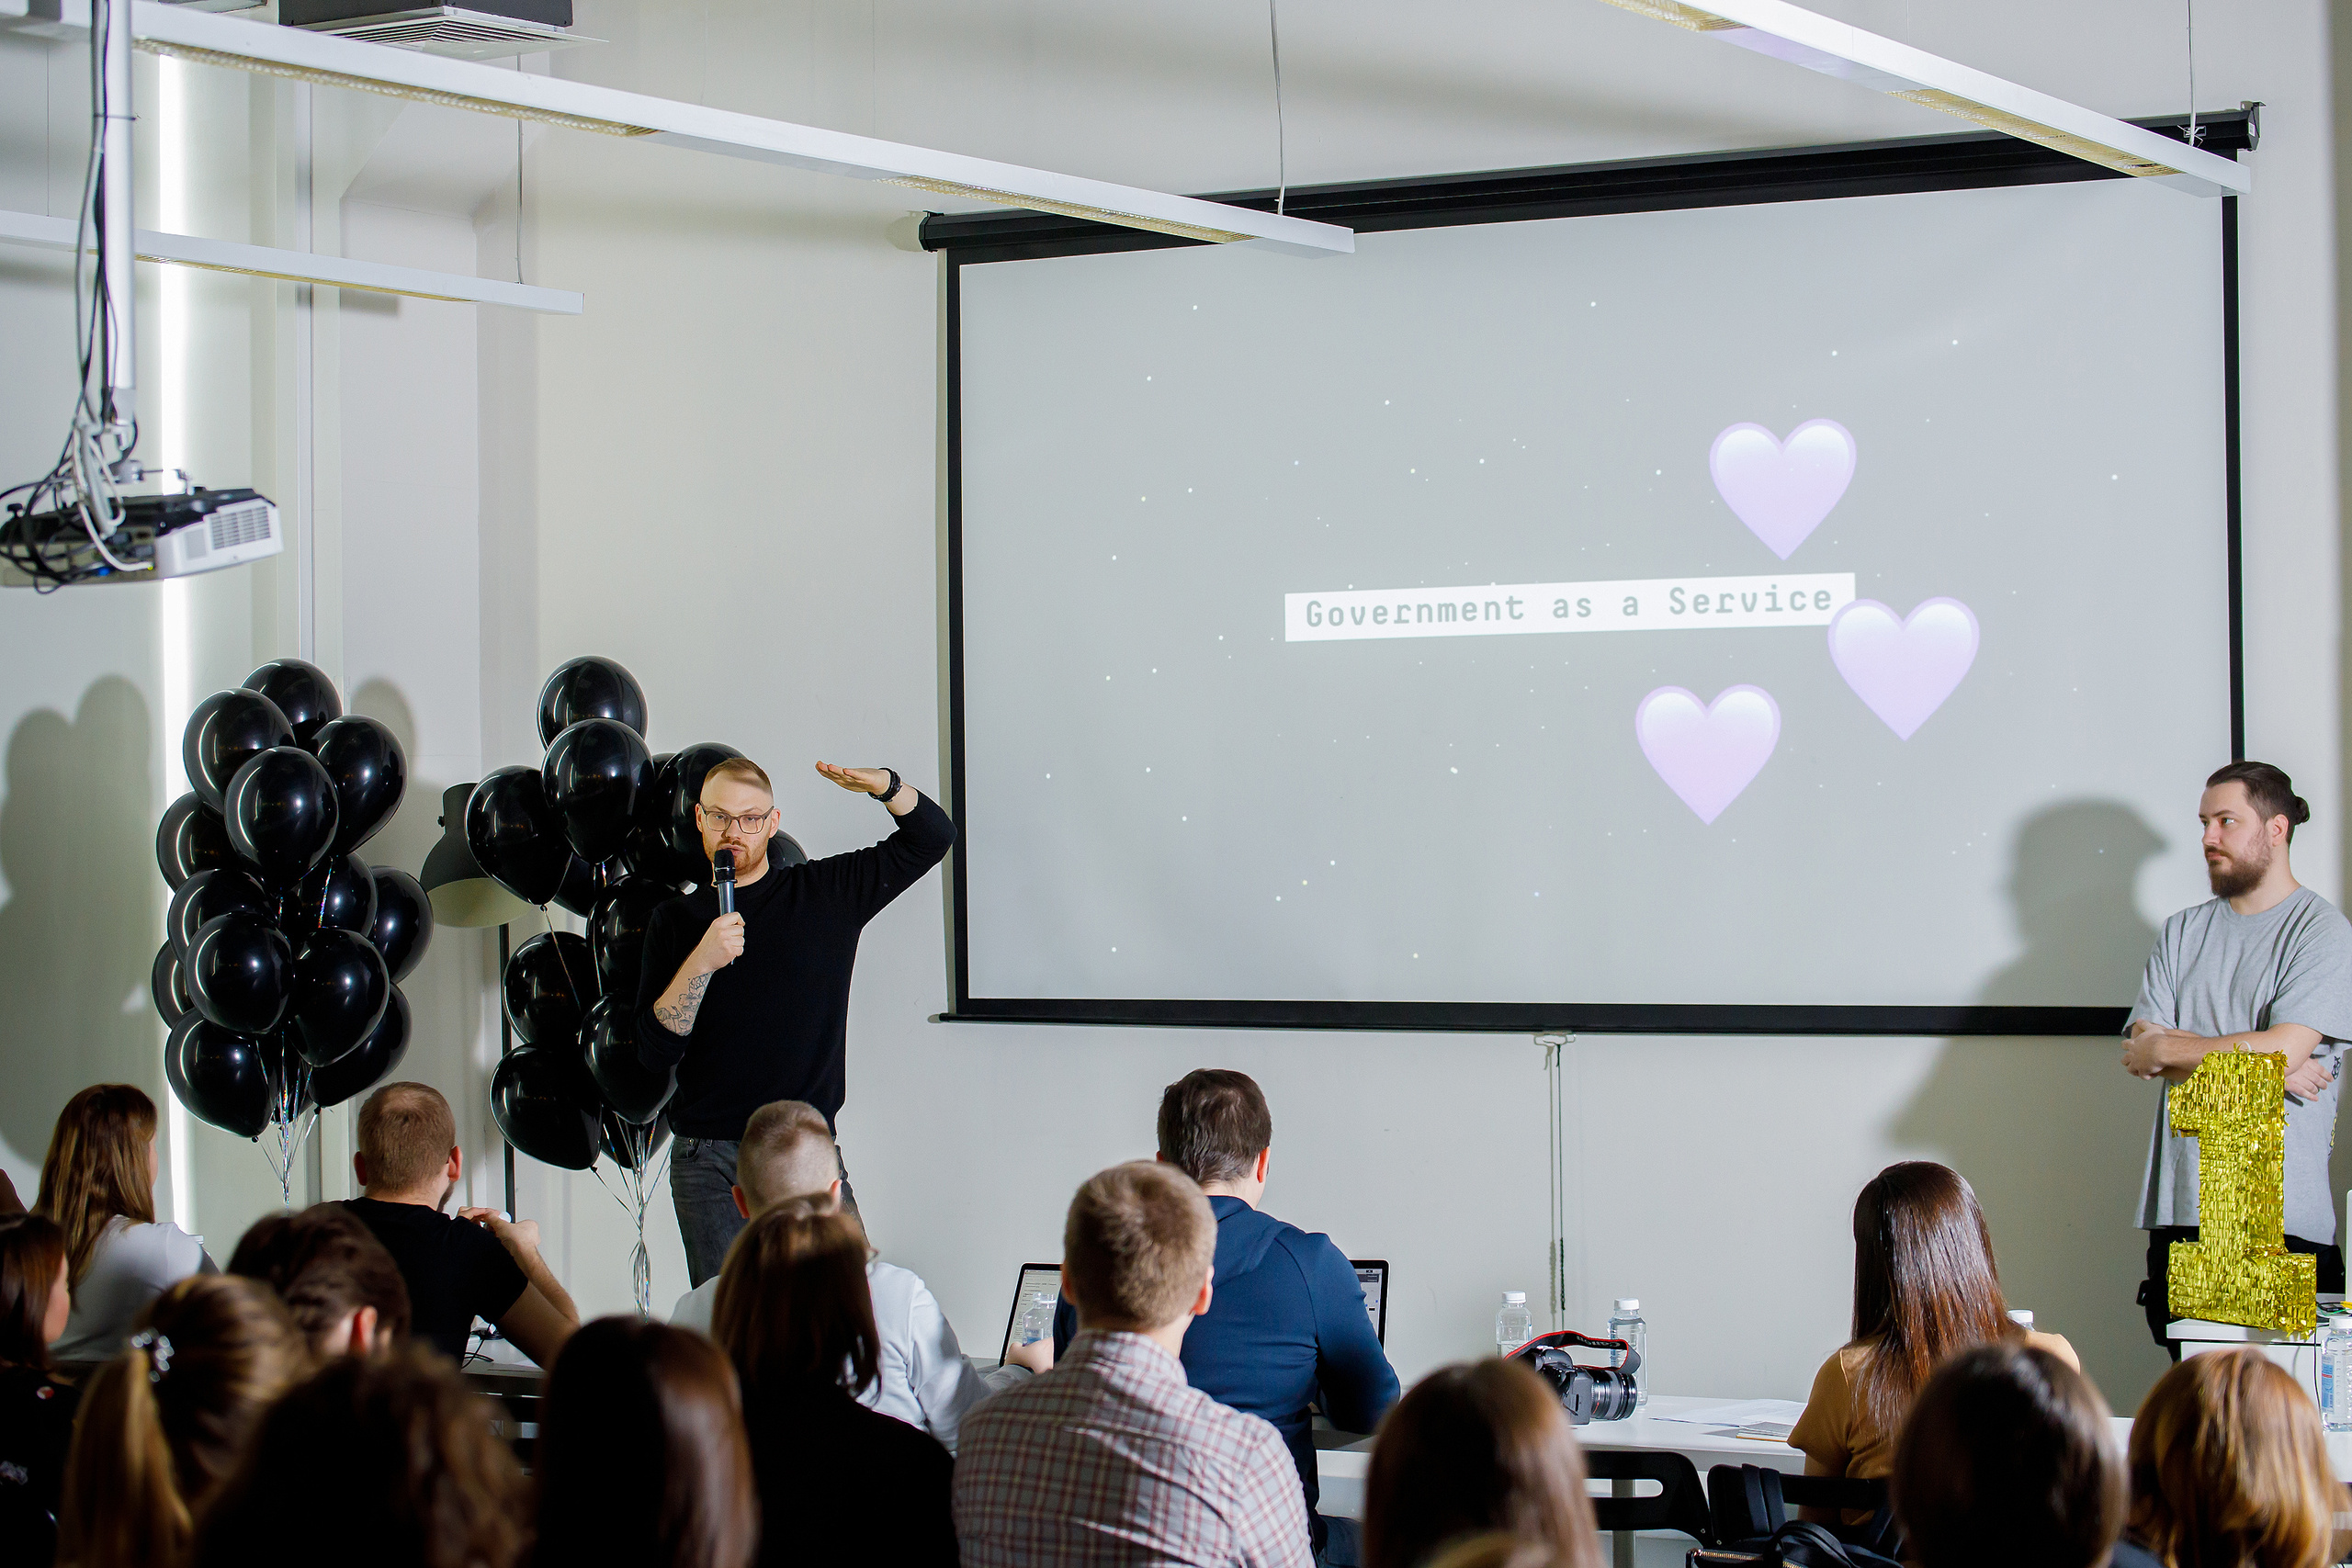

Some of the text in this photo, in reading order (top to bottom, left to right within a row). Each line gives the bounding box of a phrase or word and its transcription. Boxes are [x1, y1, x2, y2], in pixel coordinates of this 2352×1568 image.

[1306, 583, 1831, 627] Government as a Service
[2167, 1051, 2316, 1337] 1
[1576, 1335, 1621, 1348] Canon
